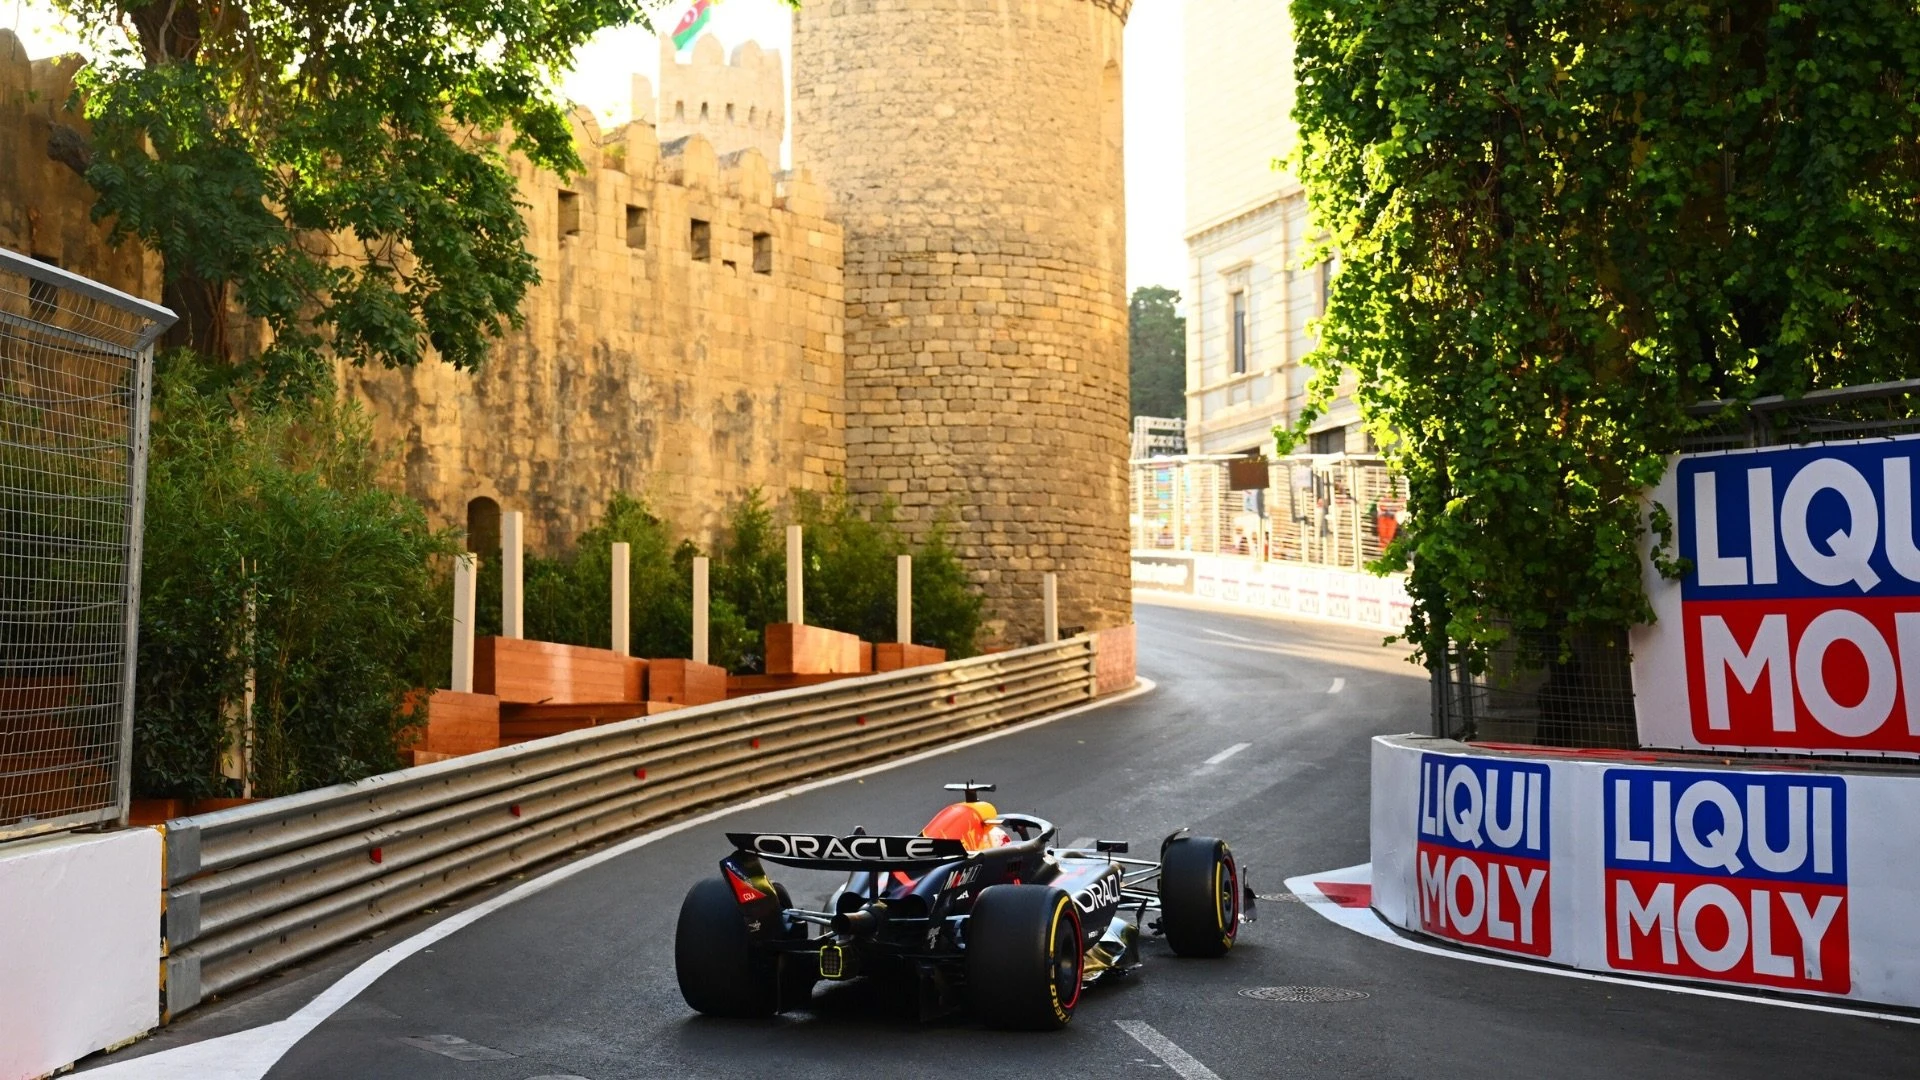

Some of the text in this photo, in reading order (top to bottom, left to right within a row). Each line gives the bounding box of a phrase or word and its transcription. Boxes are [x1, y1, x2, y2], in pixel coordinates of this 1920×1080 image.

[753, 835, 934, 859] ORACLE
[1421, 762, 1542, 851] LIQUI
[1614, 778, 1833, 875] LIQUI
[1071, 869, 1122, 913] ORACL
[1419, 850, 1547, 945] MOLY
[1615, 878, 1844, 982] MOLY
